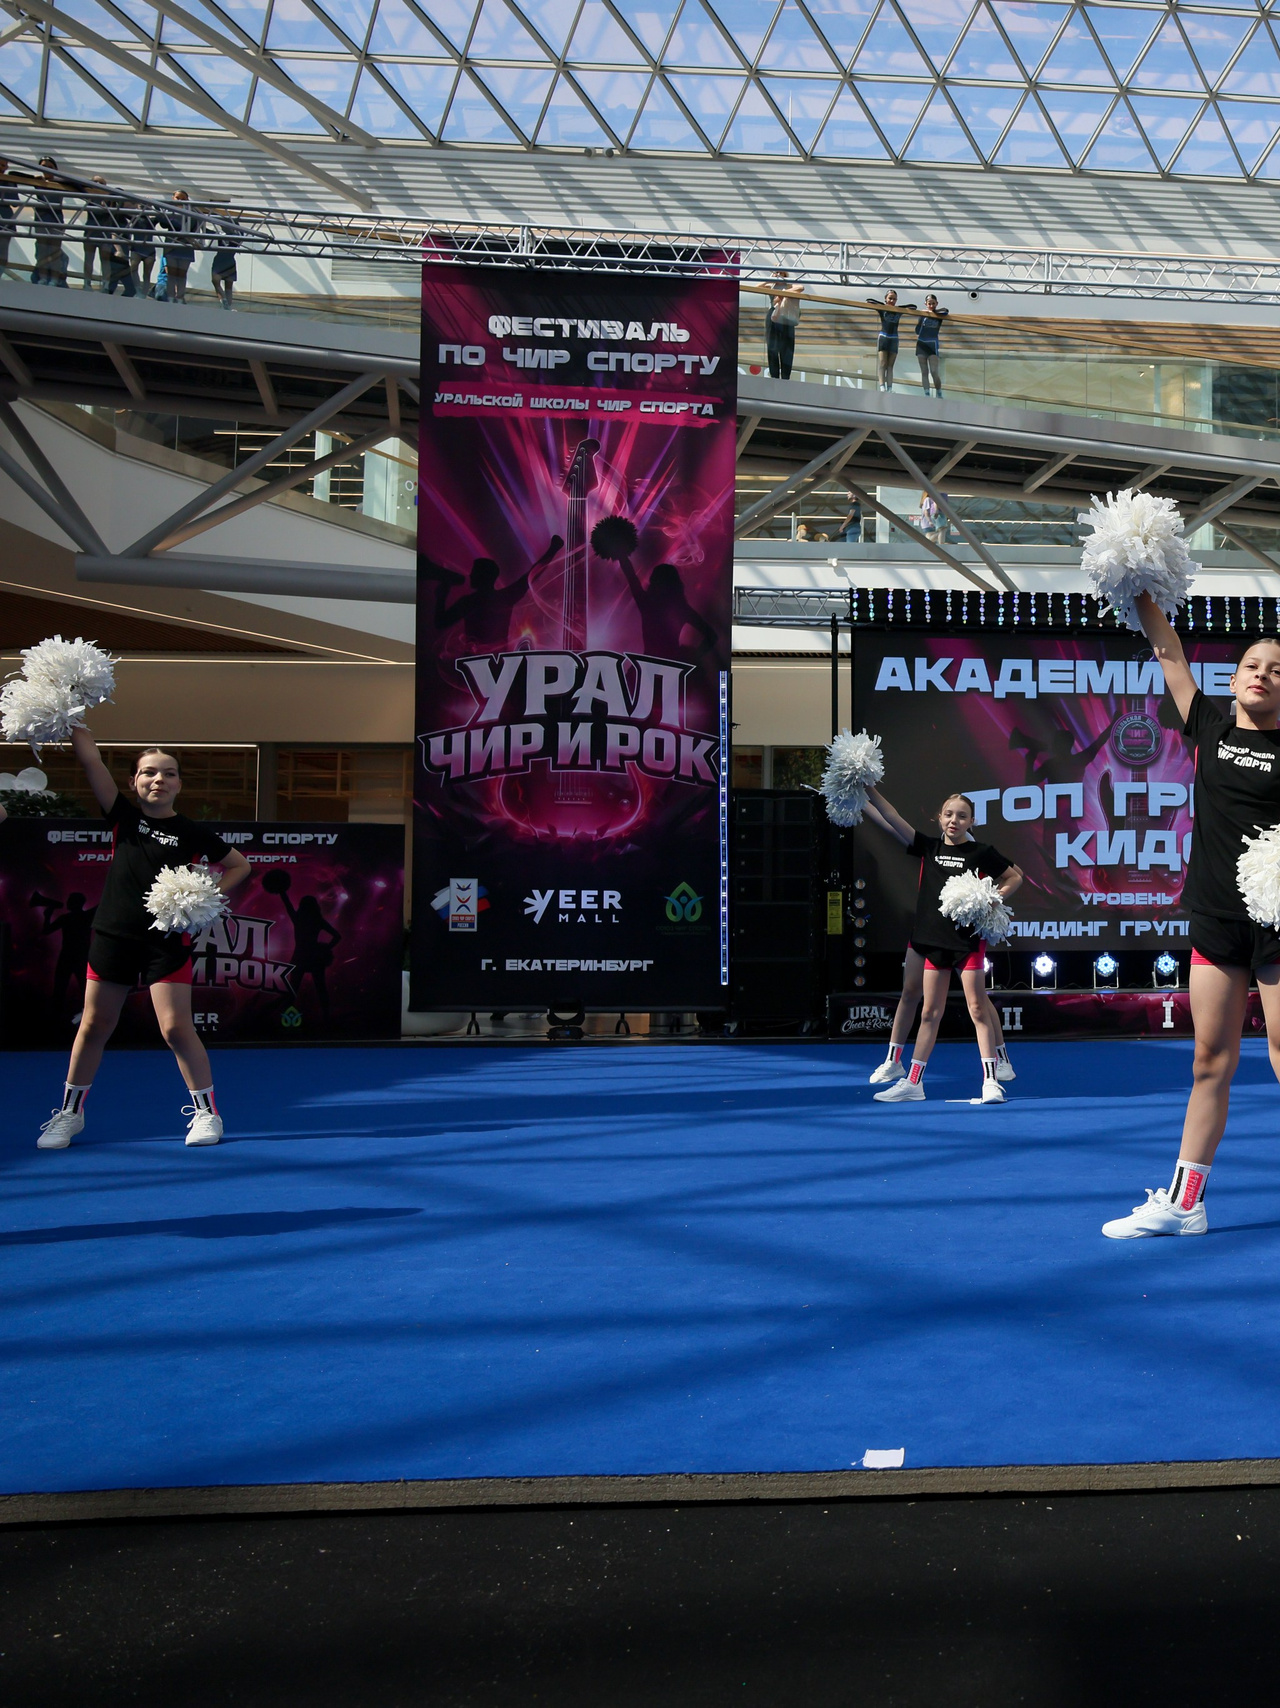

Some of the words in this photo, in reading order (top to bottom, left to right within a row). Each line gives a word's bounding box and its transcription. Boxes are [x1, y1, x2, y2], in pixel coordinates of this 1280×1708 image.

[488, 315, 690, 342] ФЕСТИВАЛЬ
[438, 344, 486, 366] ПО
[502, 347, 571, 369] ЧИР
[587, 351, 720, 375] СПОРТУ
[434, 392, 523, 408] УРАЛЬСКОЙ
[530, 397, 589, 410] ШКОЛЫ
[597, 400, 632, 412] ЧИР
[640, 402, 714, 415] СПОРТА
[463, 654, 684, 728] УРАЛ
[428, 722, 546, 779] ЧИР
[557, 722, 594, 765] И
[605, 723, 718, 784] РОК
[961, 782, 1083, 826] ТОП
[1114, 782, 1194, 817] ГР
[47, 830, 113, 843] ФЕСТИ
[263, 833, 338, 844] СПОРТУ
[247, 855, 297, 863] СПОРТА
[1080, 893, 1173, 905] УРОВЕНЬ
[558, 914, 620, 923] MALL
[1007, 921, 1108, 939] ЛИДИНГ
[193, 917, 267, 960] АЛ
[216, 957, 289, 992] РОК
[481, 959, 497, 971] Г.
[505, 959, 654, 972] ЕКАТЕРИНБУРГ
[194, 1013, 219, 1024] ER
[850, 1005, 889, 1020] URAL
[1162, 1001, 1174, 1028] I
